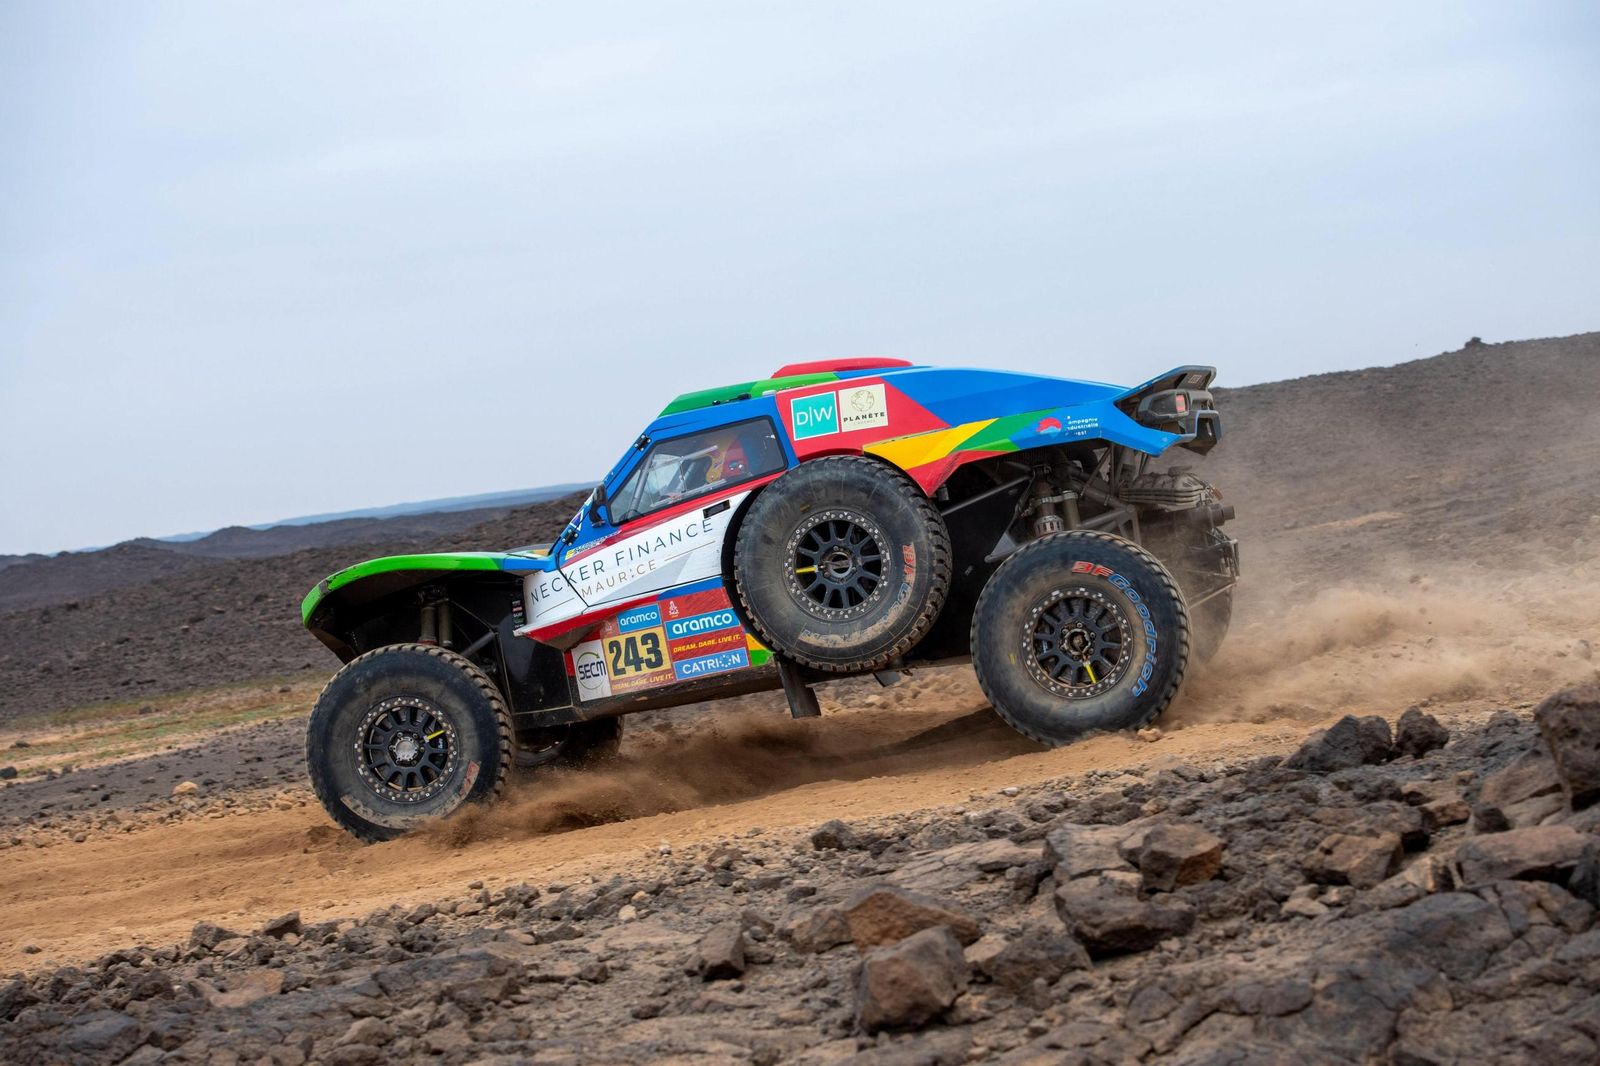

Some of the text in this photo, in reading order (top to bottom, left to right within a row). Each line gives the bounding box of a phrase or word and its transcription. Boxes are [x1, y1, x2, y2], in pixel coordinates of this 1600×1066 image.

[530, 560, 605, 605] NECKER
[615, 518, 713, 566] FINANCE
[620, 611, 658, 626] aramco
[672, 613, 733, 635] aramco
[1072, 561, 1157, 697] BFGoodrich
[608, 632, 664, 677] 243
[673, 643, 698, 653] DREAM.
[698, 639, 718, 648] DARE.
[718, 635, 732, 643] LIVE
